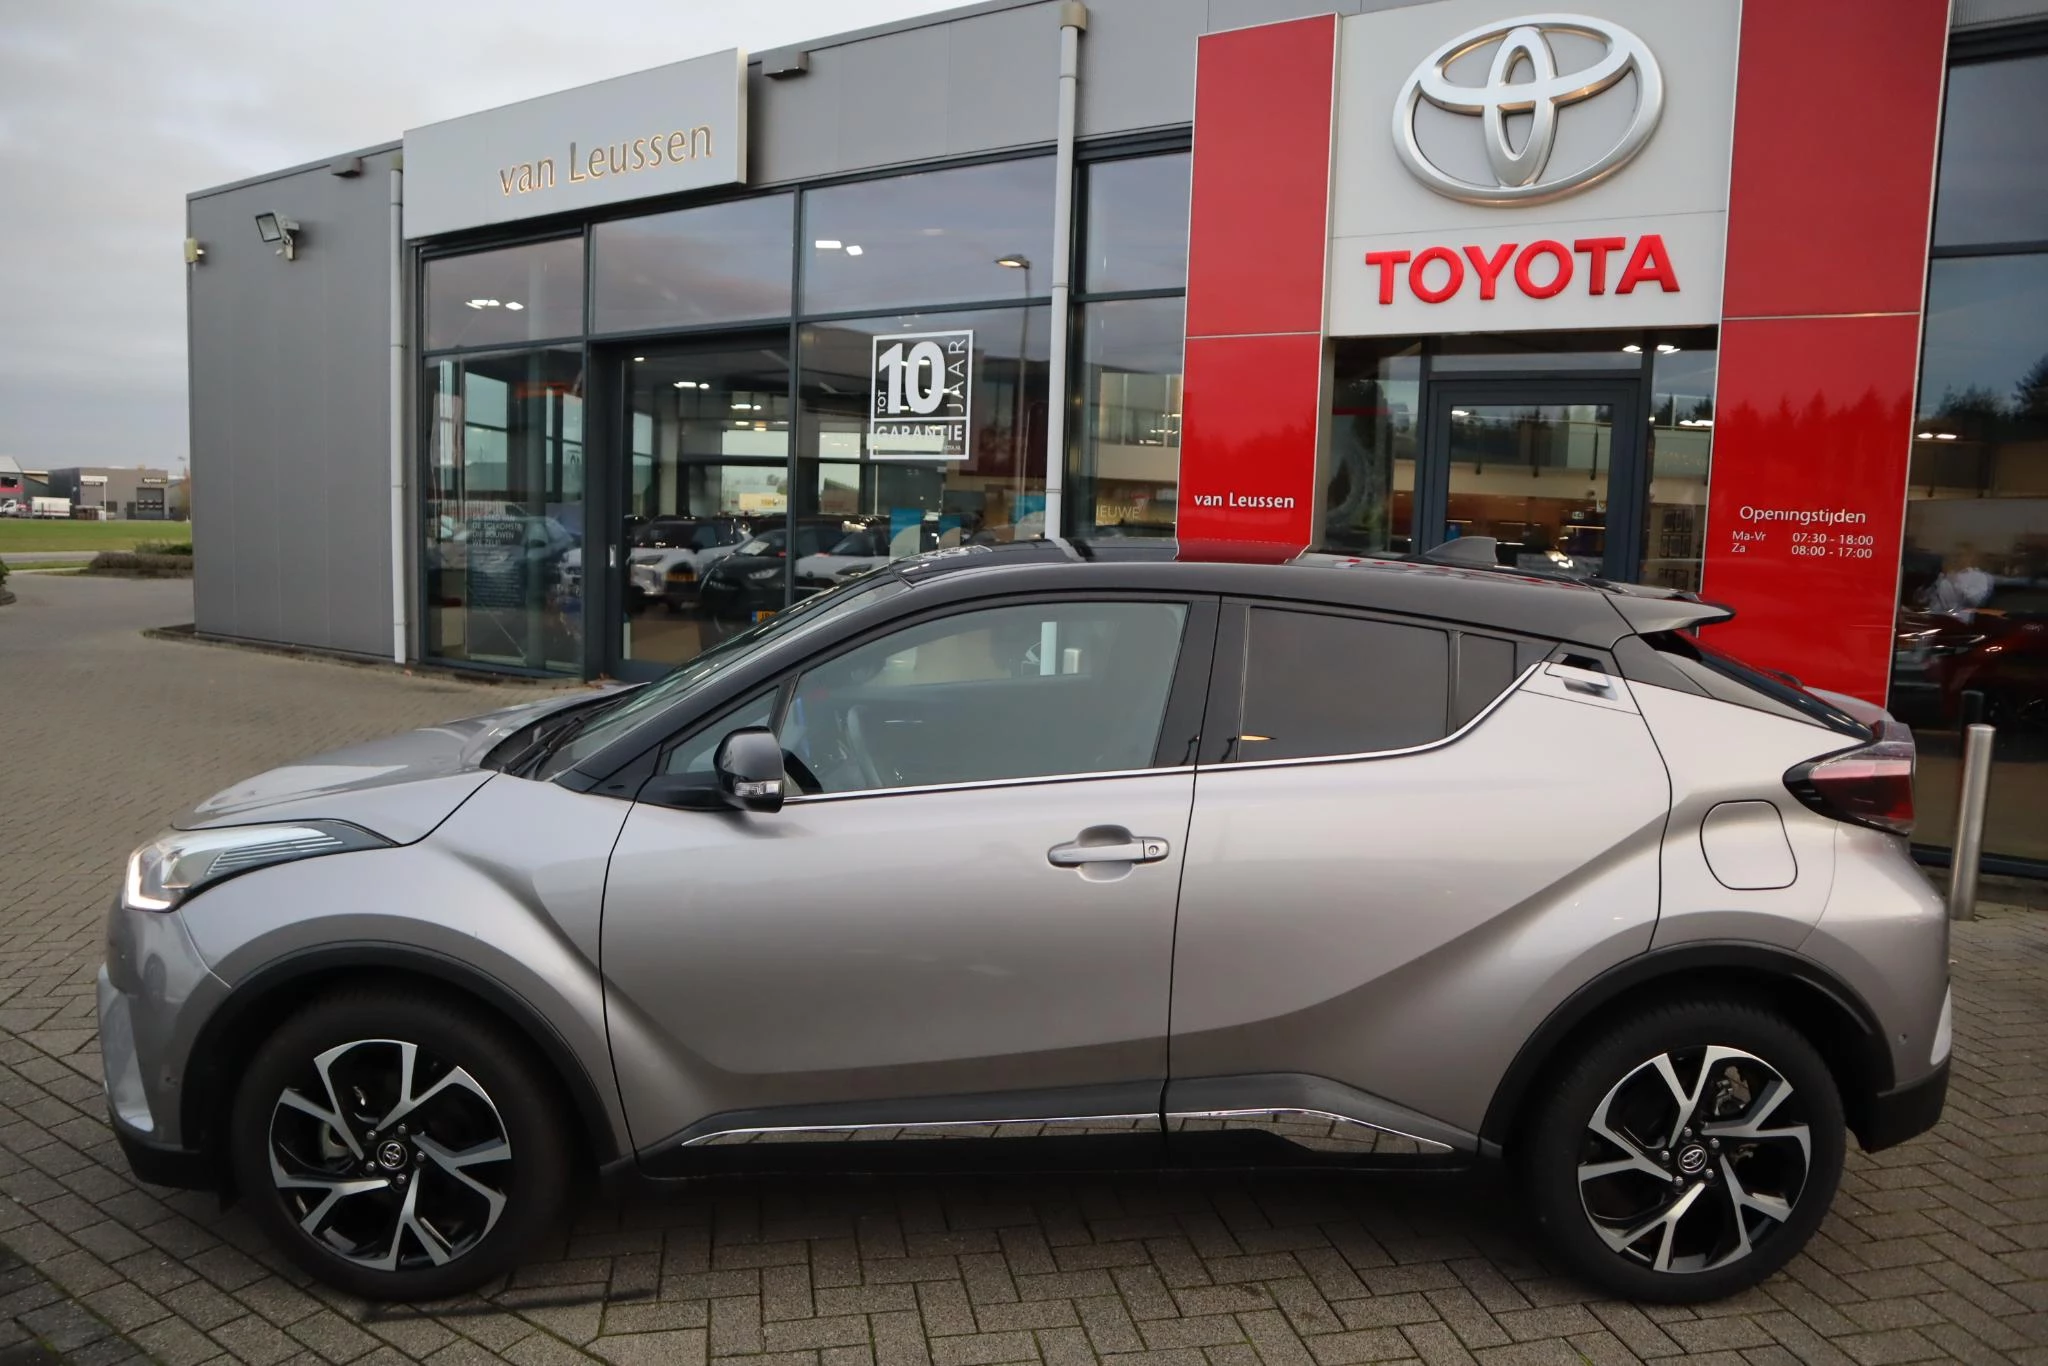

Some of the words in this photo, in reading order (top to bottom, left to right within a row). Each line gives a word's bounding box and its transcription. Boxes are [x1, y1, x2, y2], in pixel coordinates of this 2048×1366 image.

[499, 157, 555, 196] van
[568, 125, 712, 183] Leussen
[1365, 234, 1681, 305] TOYOTA
[878, 341, 945, 414] 10
[947, 339, 966, 413] JAAR
[877, 389, 887, 414] TOT
[1194, 494, 1223, 506] van
[1229, 492, 1295, 508] Leussen
[1739, 505, 1866, 526] Openingstijden
[1731, 542, 1746, 553] Za
[1791, 545, 1826, 556] 08:00
[1838, 547, 1873, 558] 17:00
[1732, 530, 1766, 541] Ma-Vr
[1792, 532, 1827, 544] 07:30
[1839, 534, 1874, 546] 18:00
